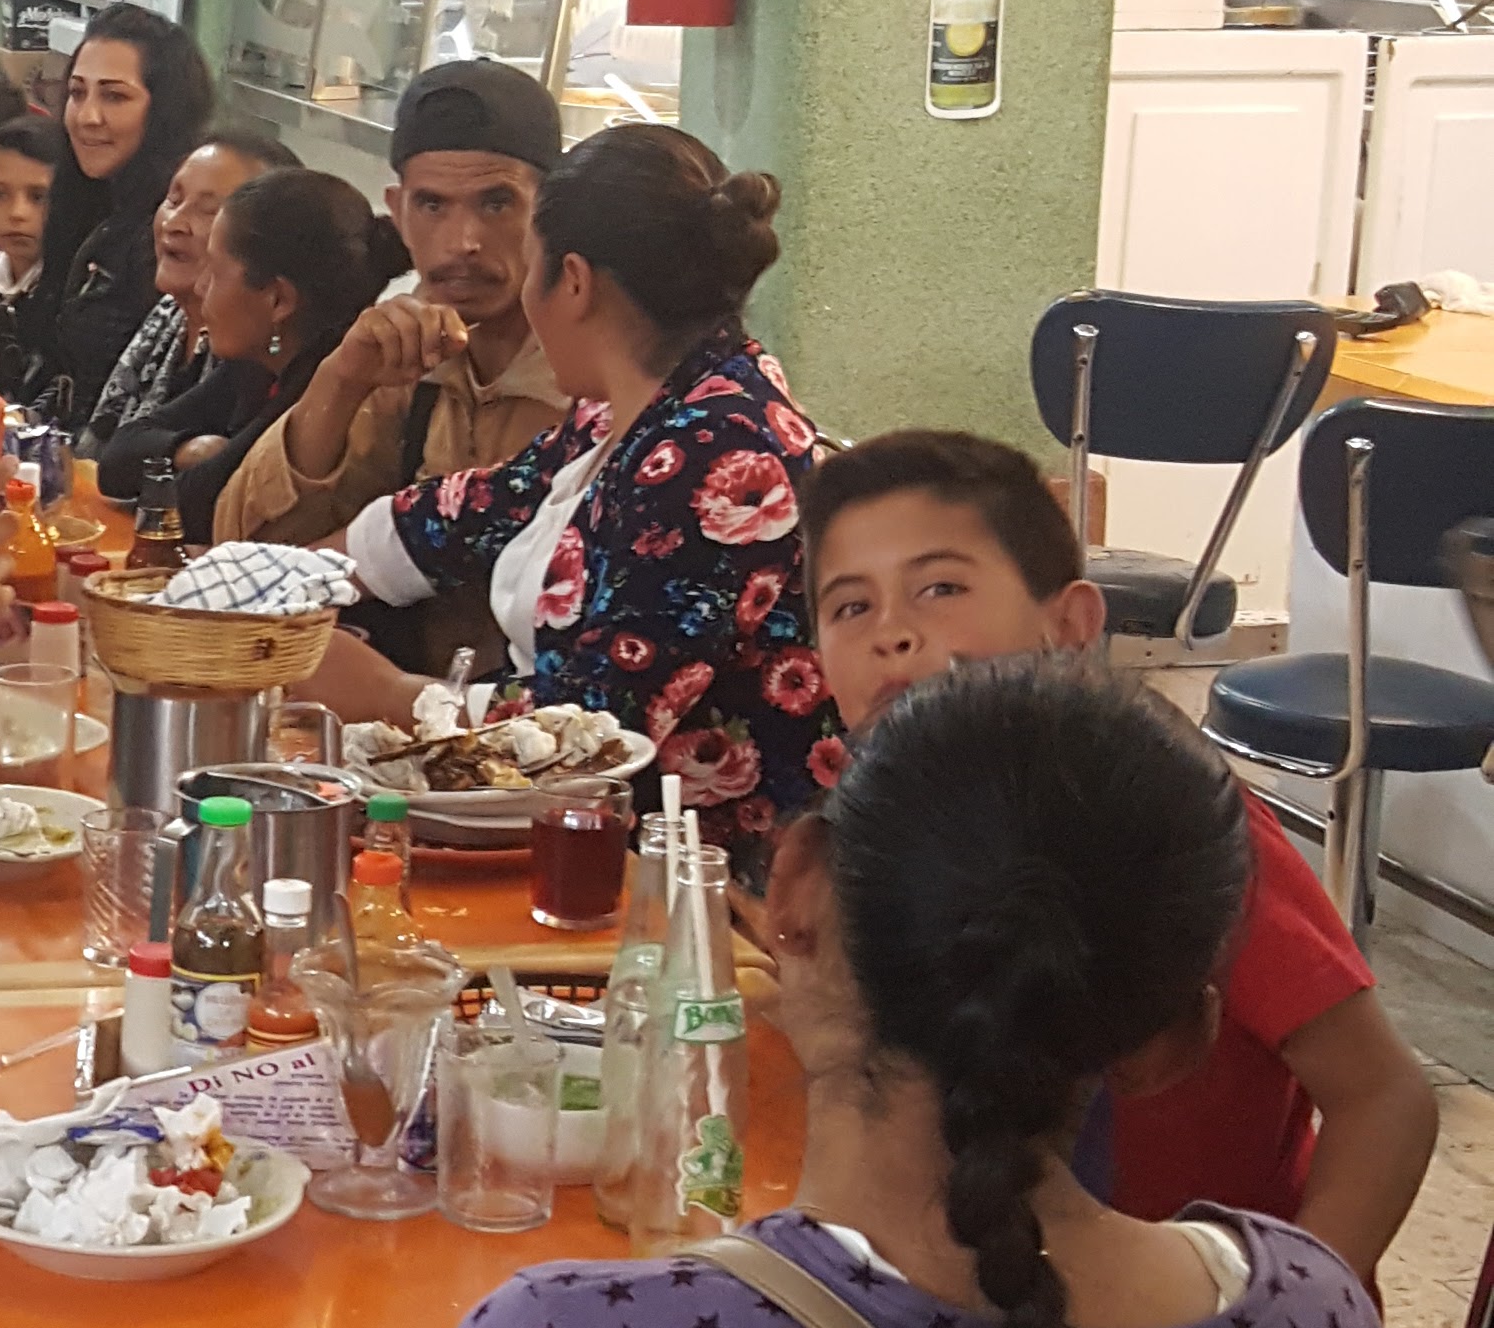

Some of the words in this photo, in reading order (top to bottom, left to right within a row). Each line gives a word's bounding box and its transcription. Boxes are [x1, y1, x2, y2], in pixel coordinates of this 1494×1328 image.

[188, 1076, 223, 1096] Di
[231, 1062, 280, 1084] NO
[291, 1052, 317, 1070] al
